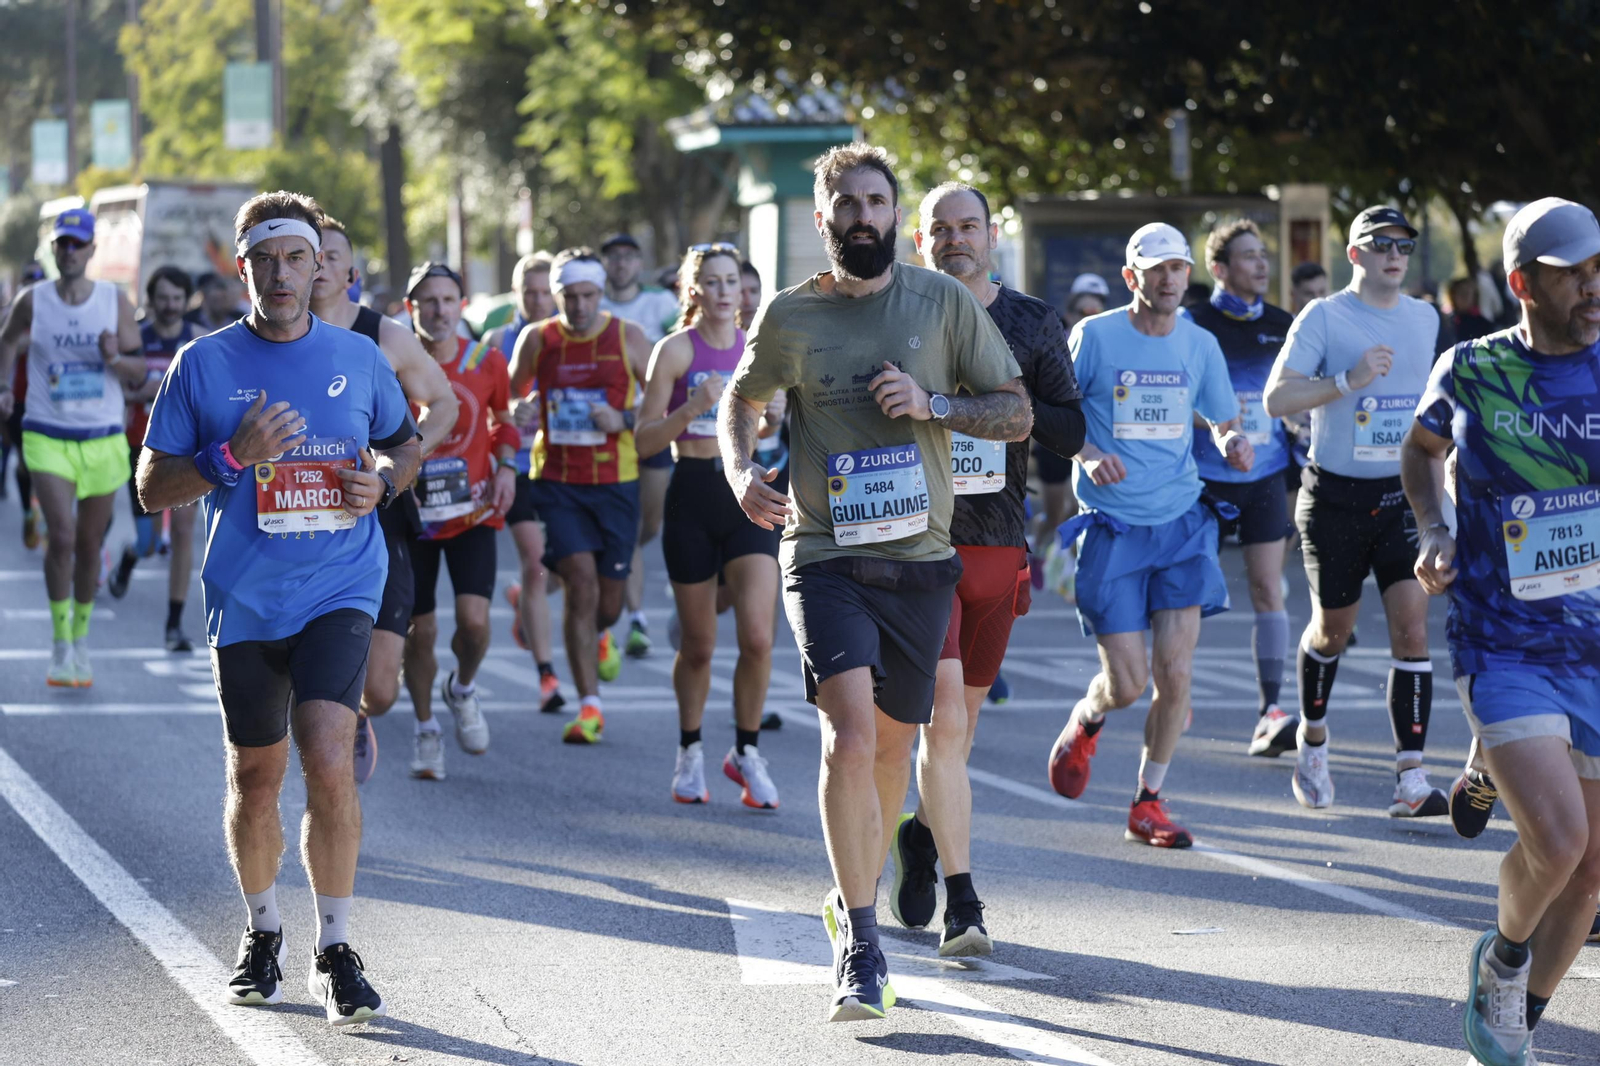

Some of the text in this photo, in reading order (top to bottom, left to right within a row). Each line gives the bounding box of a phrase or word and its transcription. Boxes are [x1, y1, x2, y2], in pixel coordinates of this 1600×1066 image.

[53, 333, 97, 347] YALE
[1141, 374, 1180, 384] ZURICH
[829, 388, 850, 396] KUTXA
[813, 397, 851, 408] DONOSTIA
[1141, 395, 1163, 404] 5235
[1381, 398, 1416, 409] ZURICH
[1134, 408, 1169, 422] KENT
[1494, 410, 1600, 440] RUNNE
[291, 443, 345, 457] ZURICH
[860, 450, 915, 468] ZURICH
[293, 470, 323, 484] 1252
[864, 480, 895, 495] 5484
[274, 488, 342, 509] MARCO
[832, 493, 928, 523] GUILLAUME
[1548, 523, 1583, 541] 7813
[1534, 541, 1600, 572] ANGEL
